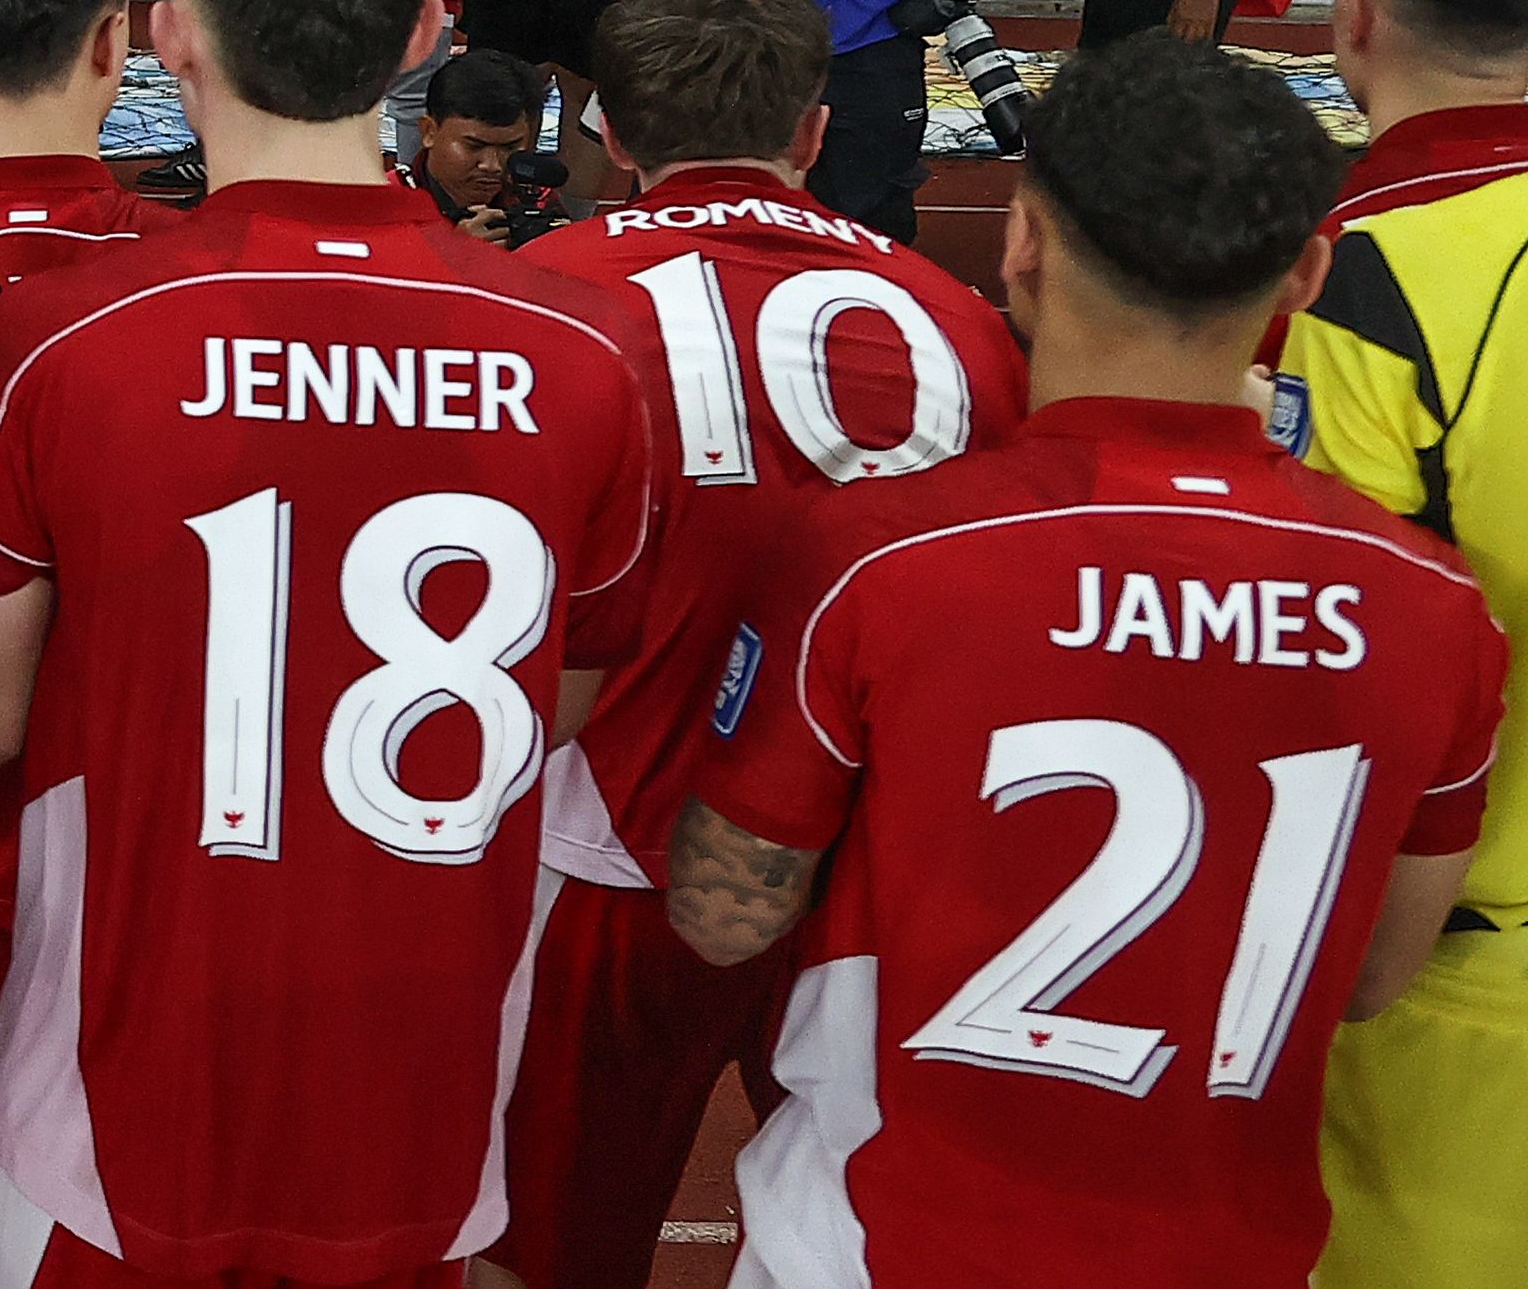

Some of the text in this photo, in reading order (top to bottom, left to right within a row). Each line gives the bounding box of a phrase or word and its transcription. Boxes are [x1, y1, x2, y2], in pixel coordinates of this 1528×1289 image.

[605, 197, 895, 255] ROMENY
[180, 336, 540, 435] JENNER
[626, 250, 973, 488] 10
[182, 485, 557, 866] 18
[1048, 565, 1367, 671] JAMES
[900, 717, 1373, 1101] 21
